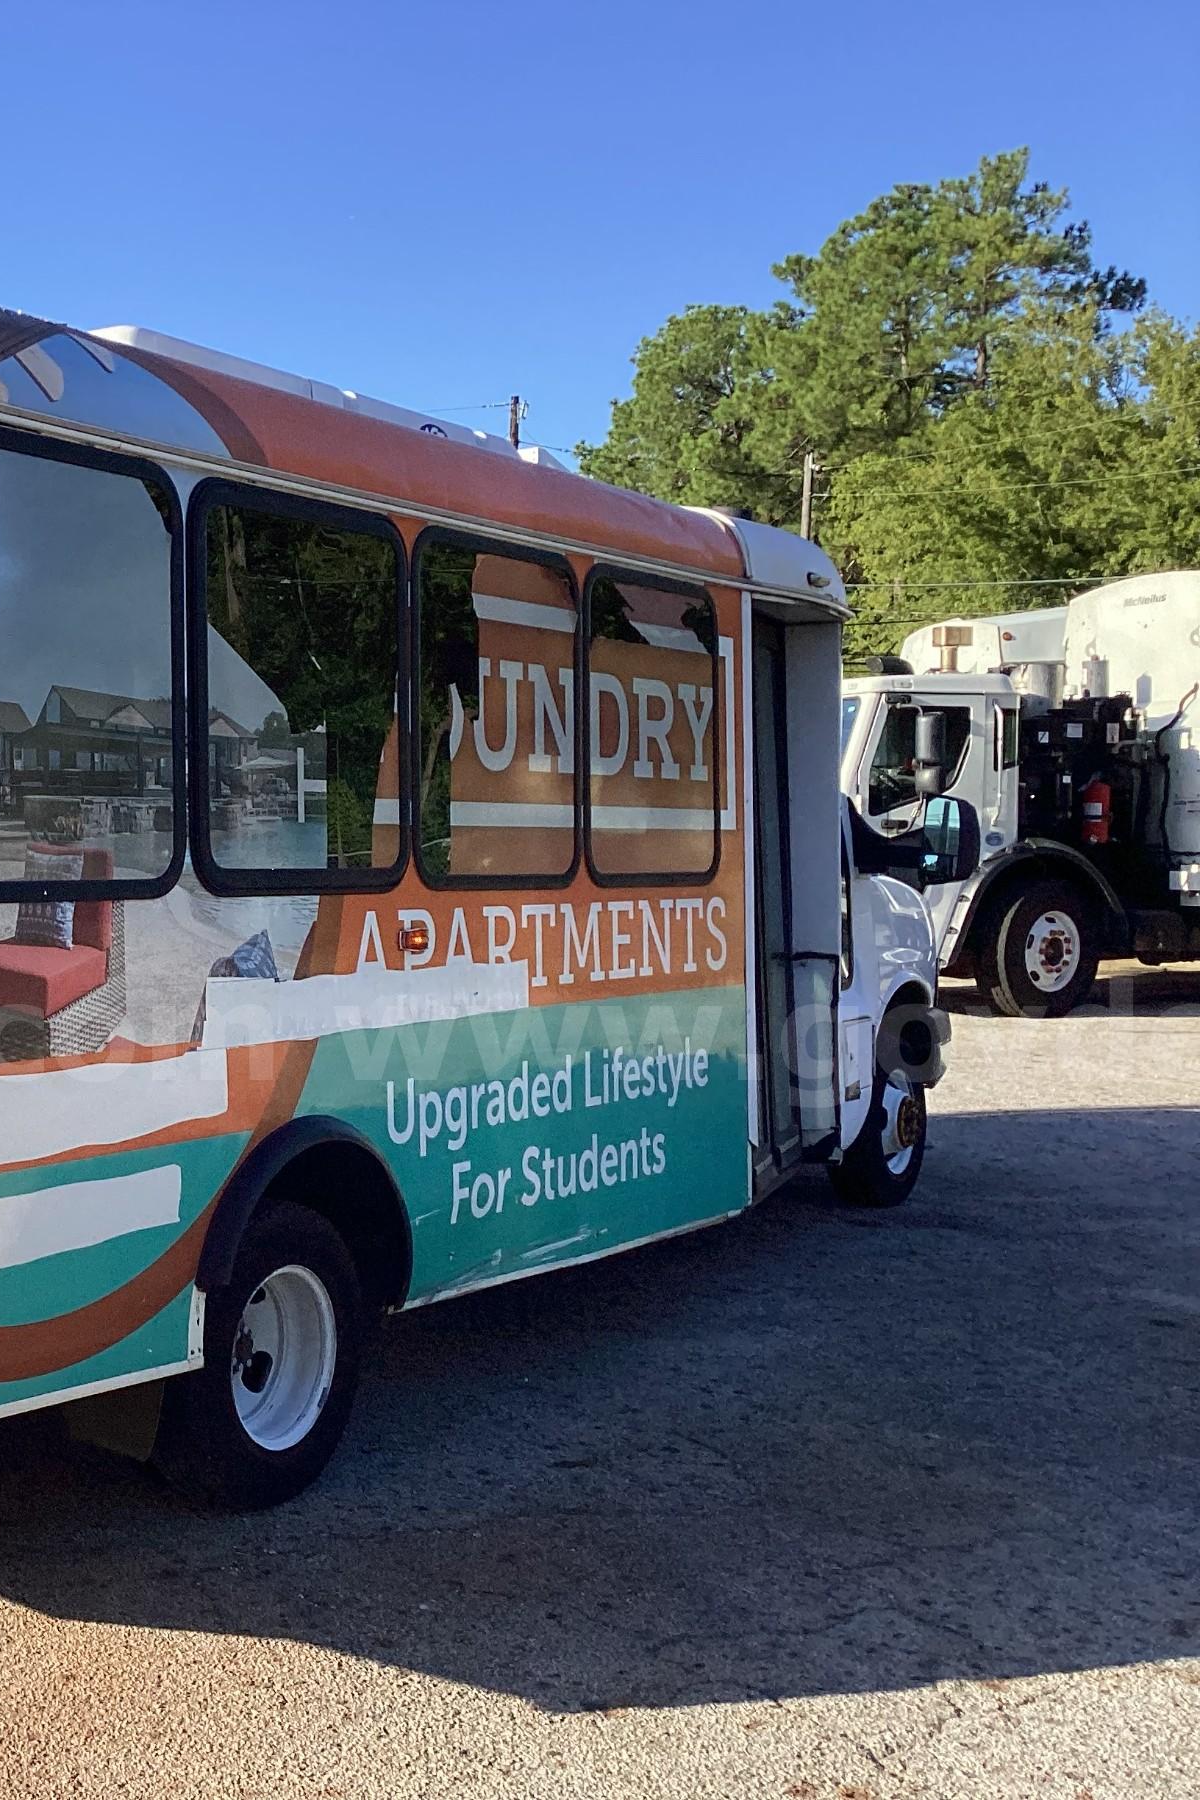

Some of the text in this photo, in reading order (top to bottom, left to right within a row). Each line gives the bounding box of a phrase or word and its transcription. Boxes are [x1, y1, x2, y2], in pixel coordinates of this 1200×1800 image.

[449, 657, 714, 782] UNDRY
[355, 896, 728, 988] APARTMENTS
[386, 1037, 710, 1157] Upgraded Lifestyle
[449, 1128, 667, 1225] For Students
